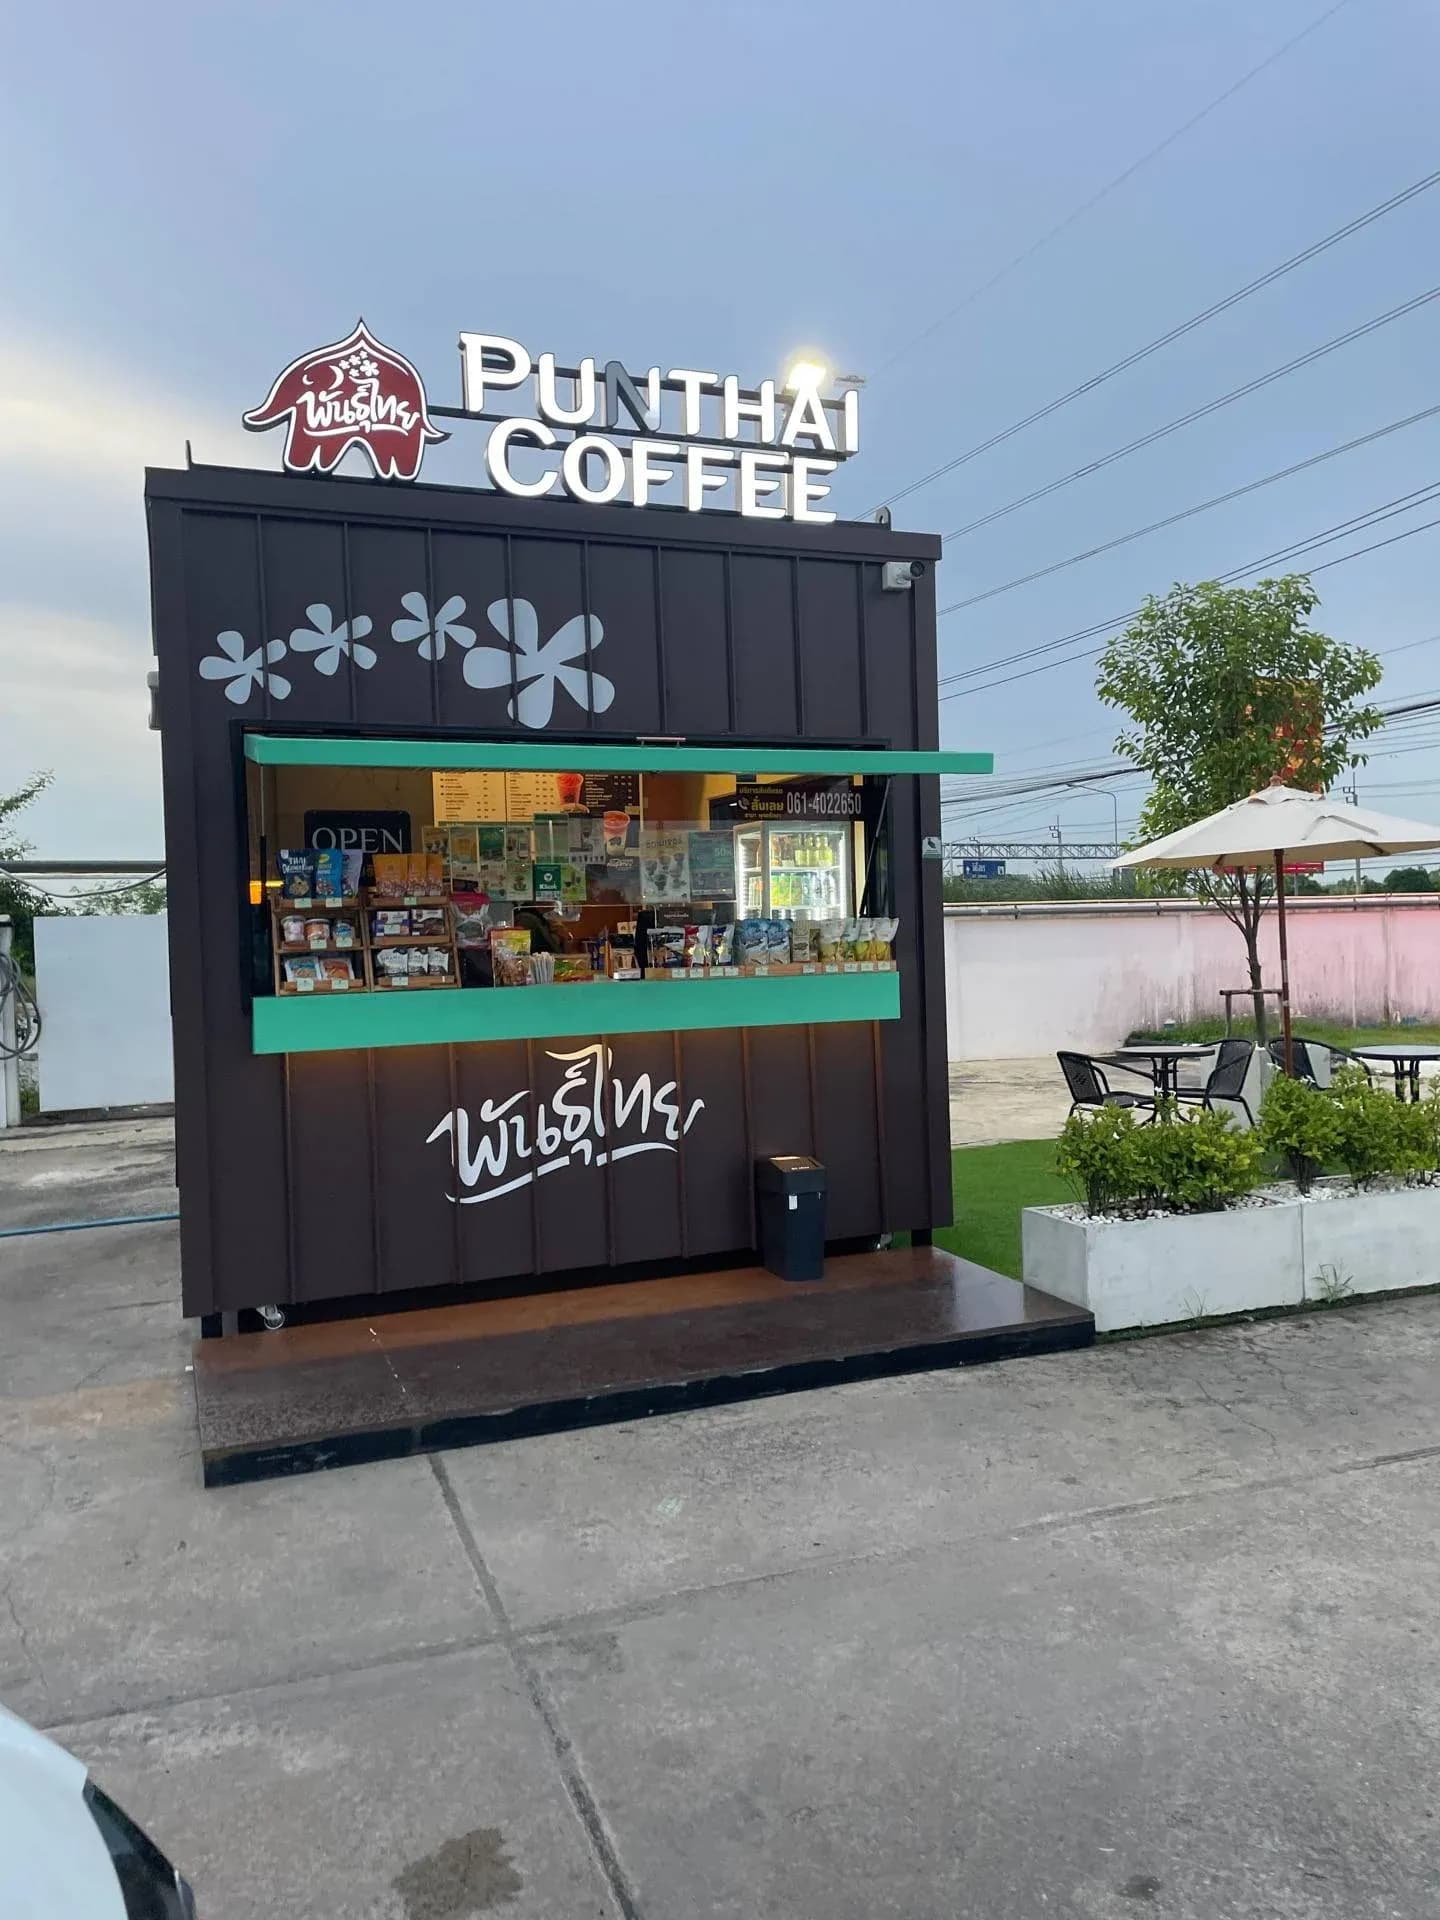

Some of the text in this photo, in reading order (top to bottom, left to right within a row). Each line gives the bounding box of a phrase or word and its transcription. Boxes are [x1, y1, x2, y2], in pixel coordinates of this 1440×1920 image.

[296, 376, 420, 434] พันธุ์ไทย
[458, 331, 859, 452] PUNTHAI
[485, 416, 838, 523] COFFEE
[312, 827, 403, 854] OPEN
[786, 791, 862, 815] 061-4022650
[425, 1043, 706, 1187] พันธุ์ไทย
